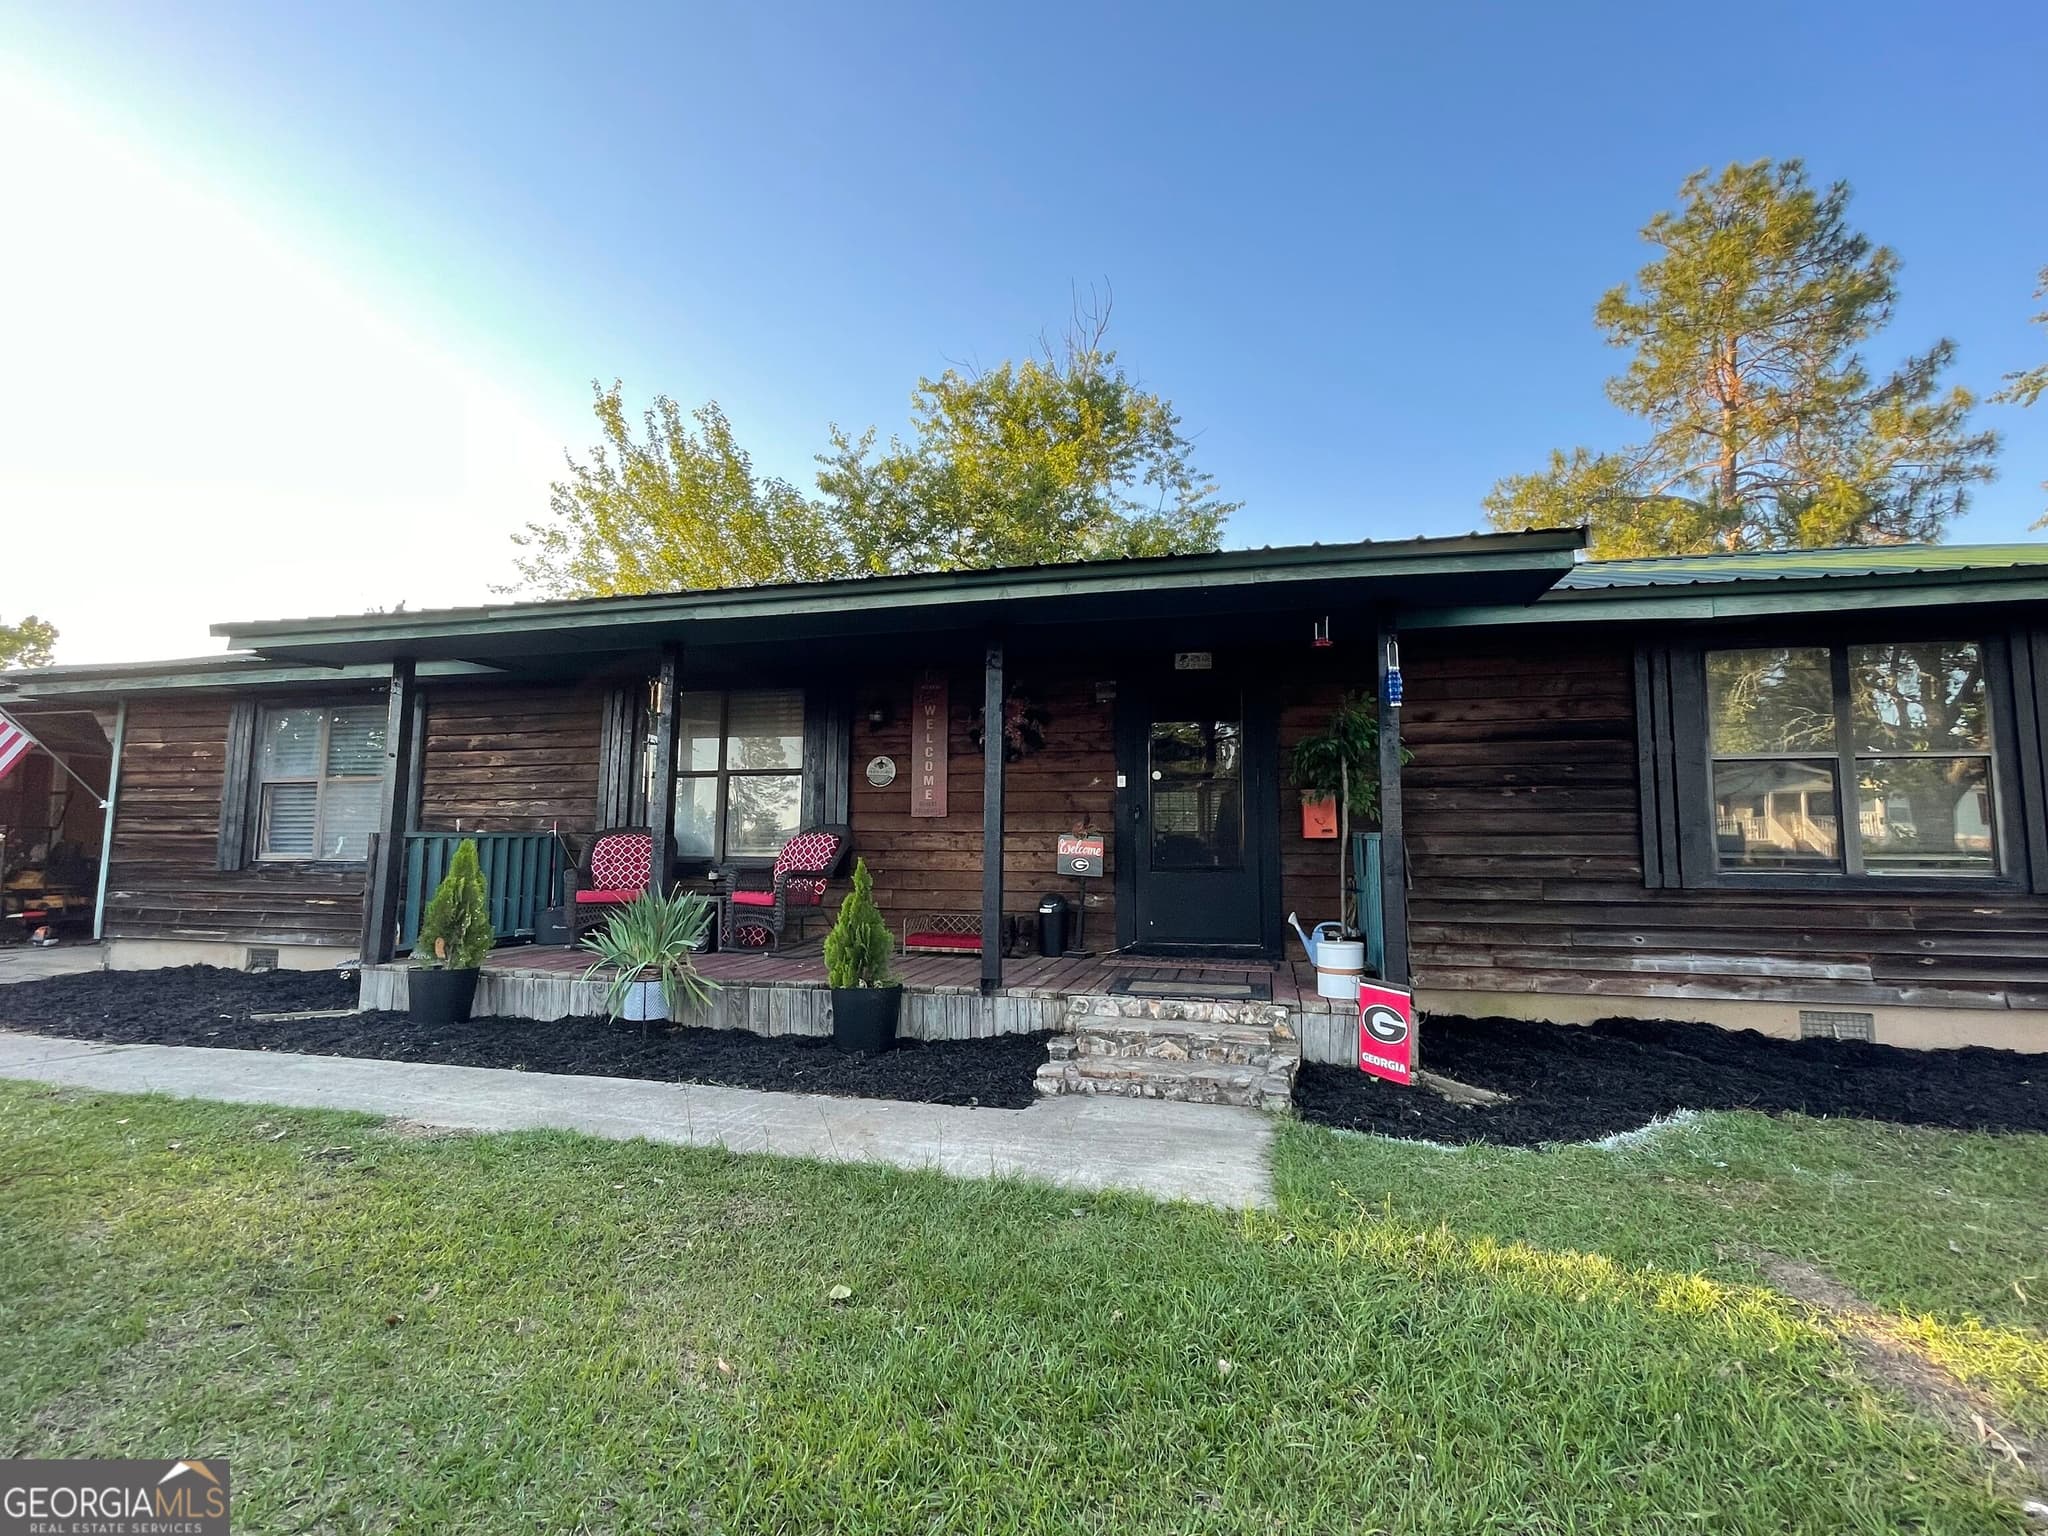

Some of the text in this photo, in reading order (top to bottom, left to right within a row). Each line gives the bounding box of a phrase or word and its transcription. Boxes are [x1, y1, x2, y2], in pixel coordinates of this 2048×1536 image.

[923, 705, 936, 800] WELCOME
[1059, 839, 1103, 857] Welcome
[1071, 857, 1089, 871] G
[1362, 1004, 1408, 1044] G
[1362, 1052, 1406, 1074] GEORGIA
